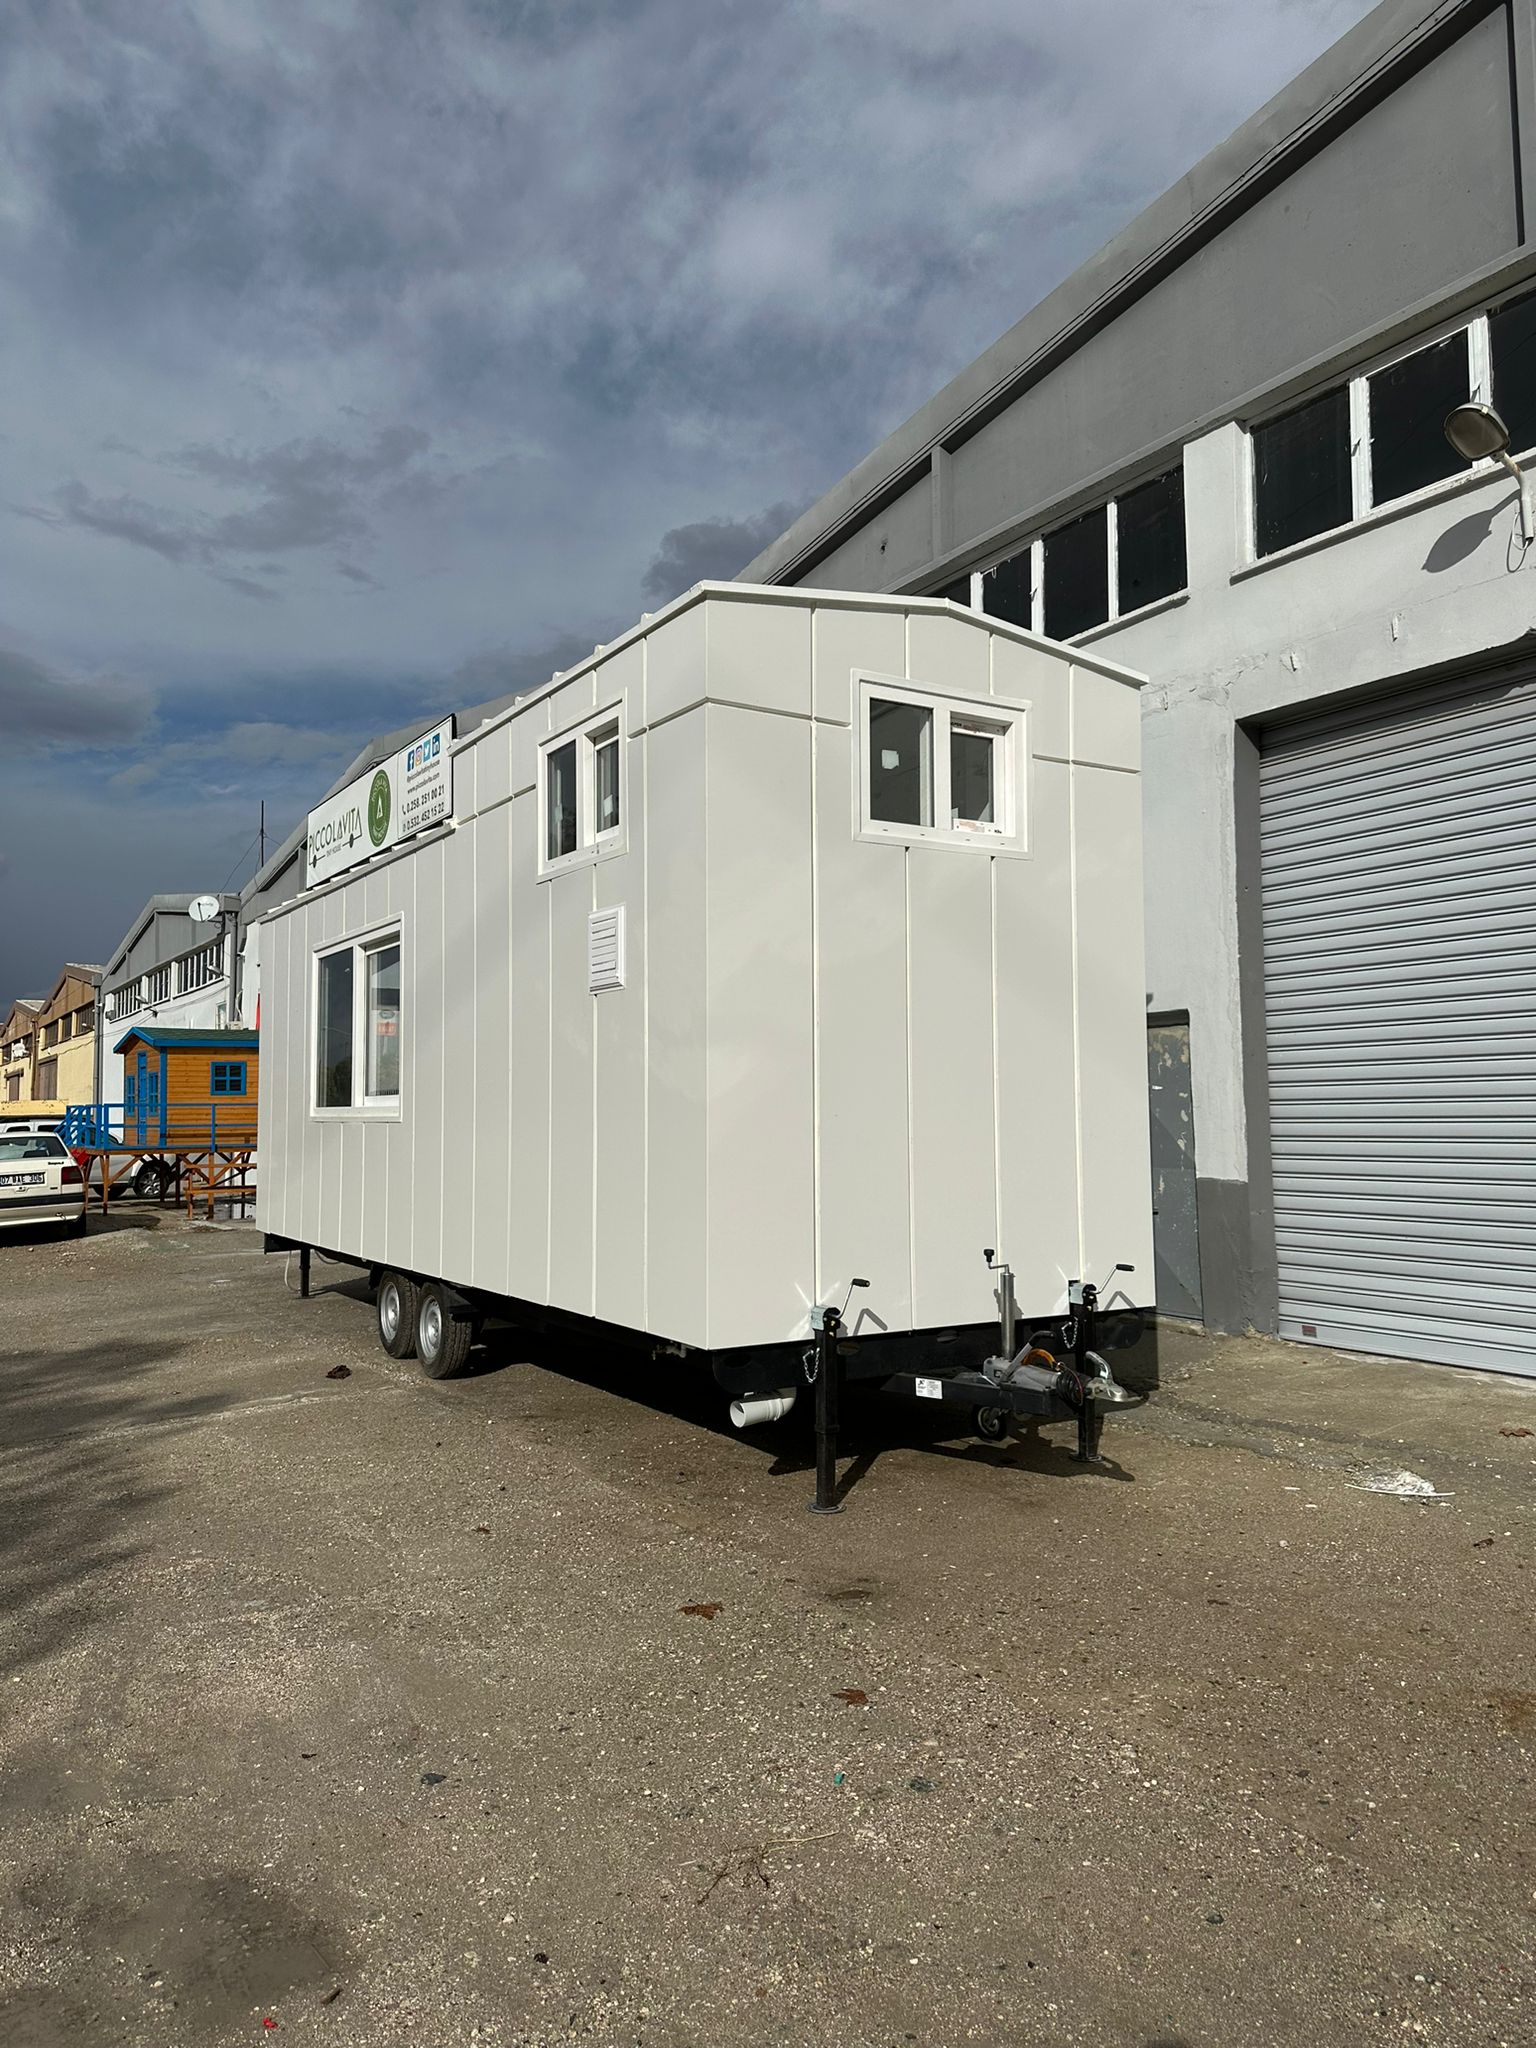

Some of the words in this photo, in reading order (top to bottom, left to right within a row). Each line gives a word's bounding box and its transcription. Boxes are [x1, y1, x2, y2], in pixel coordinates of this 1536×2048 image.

[421, 792, 430, 806] 251
[431, 787, 438, 800] 00
[438, 783, 445, 796] 21
[421, 808, 430, 821] 452
[430, 805, 437, 817] 15
[438, 801, 445, 814] 22
[308, 806, 362, 856] PICCOLAVITA
